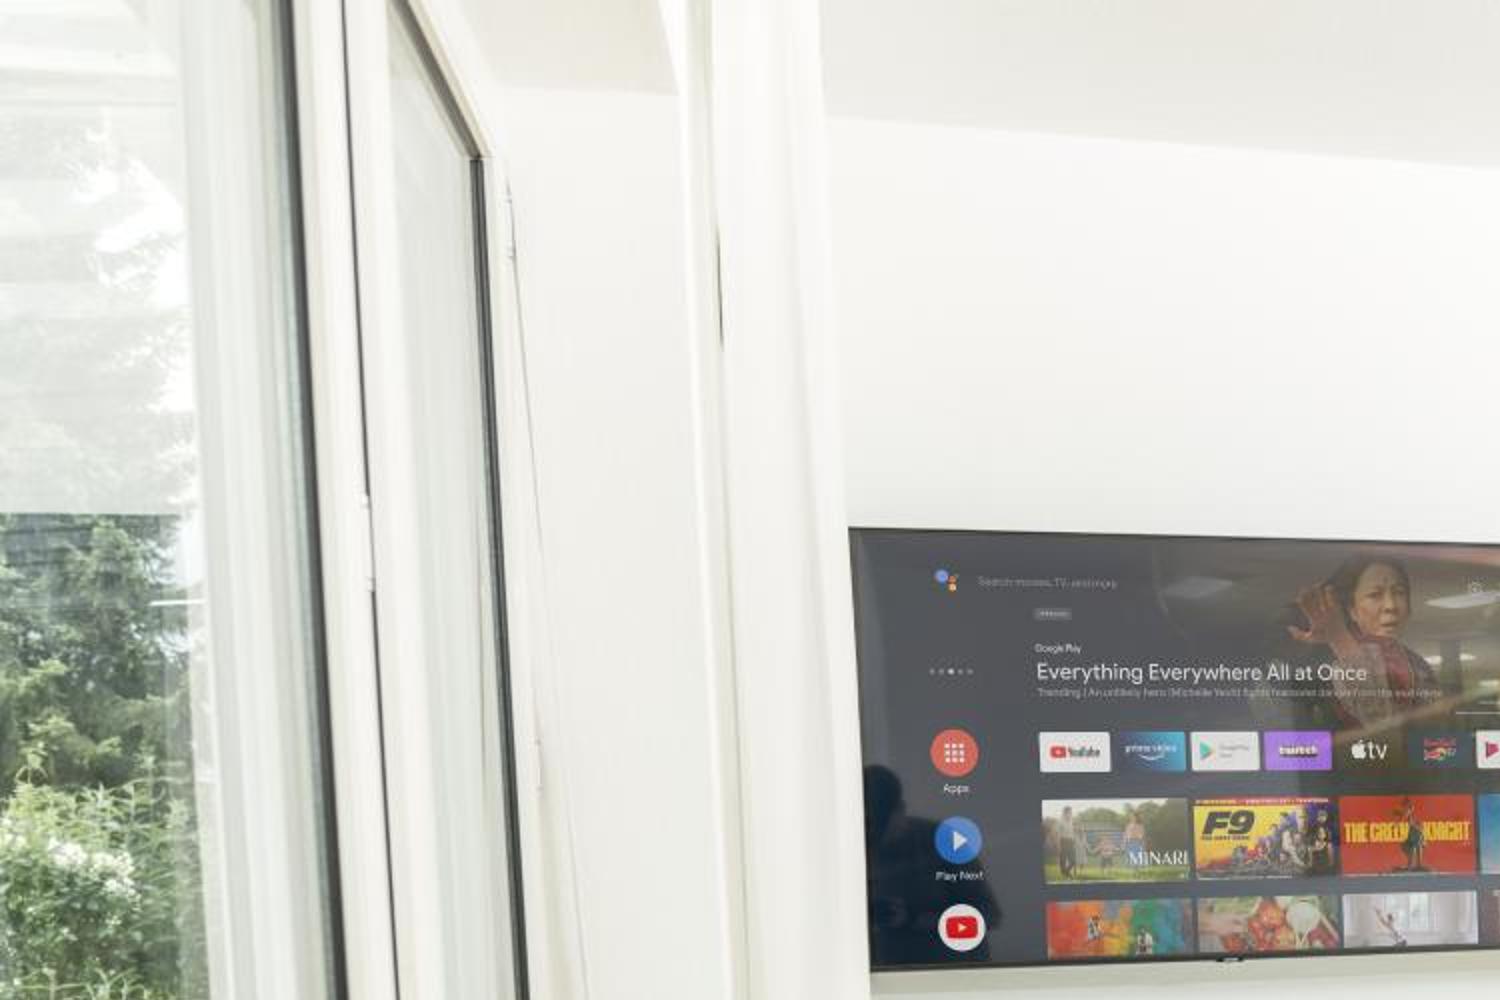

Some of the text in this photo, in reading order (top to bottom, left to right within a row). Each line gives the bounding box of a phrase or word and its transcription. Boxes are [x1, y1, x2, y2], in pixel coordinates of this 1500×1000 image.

[1037, 662, 1367, 685] Everything Everywhere All at Once
[1367, 741, 1388, 760] tv
[943, 783, 970, 796] Apps
[1202, 809, 1256, 835] F9
[1344, 820, 1472, 843] THE GREEN KNIGHT
[1128, 849, 1189, 866] MINARI
[935, 870, 985, 882] Play Next
